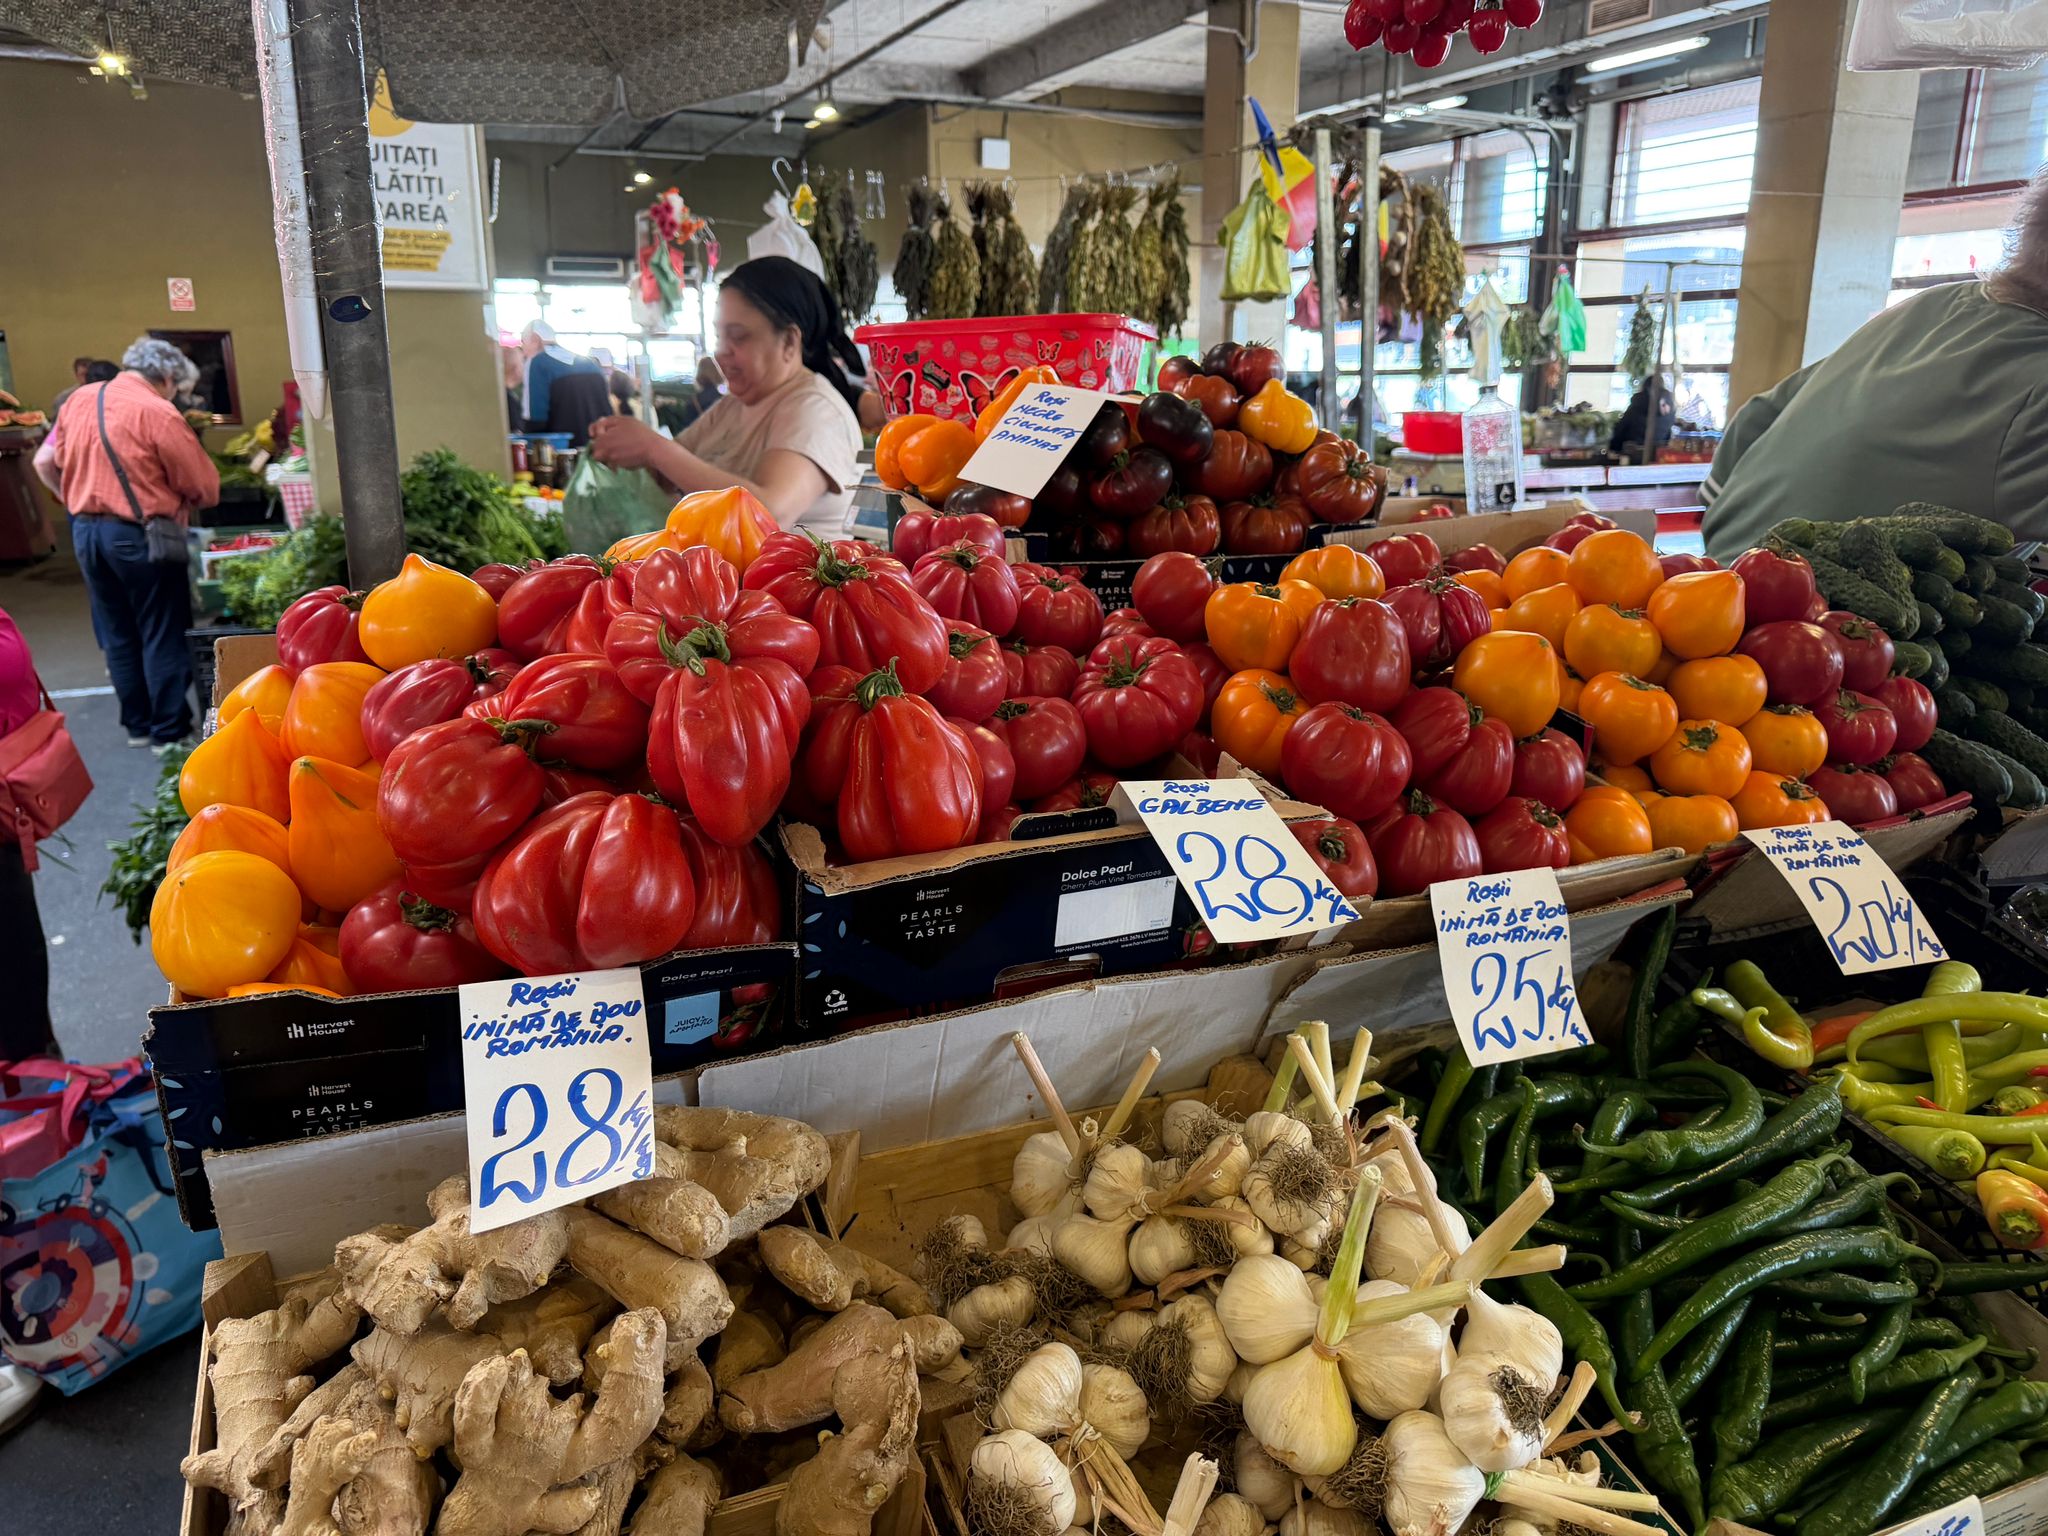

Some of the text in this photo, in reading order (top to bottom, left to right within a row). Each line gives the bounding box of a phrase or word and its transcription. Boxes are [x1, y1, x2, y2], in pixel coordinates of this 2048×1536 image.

[991, 430, 1062, 451] ANANAS
[1138, 797, 1267, 815] GALBENE
[1812, 840, 1834, 854] DE
[1060, 869, 1162, 892] Cherry Plum Vine Tomatoes
[1061, 861, 1133, 882] Dolce Pearl
[926, 887, 950, 895] Harvest
[900, 904, 963, 923] PEARLS
[1503, 907, 1534, 927] DE
[1534, 900, 1568, 920] BOU
[905, 924, 956, 940] TASTE
[925, 919, 937, 927] OF
[661, 973, 698, 983] Dolce
[700, 966, 733, 977] Pearl
[550, 1010, 583, 1031] DE
[590, 999, 643, 1025] BOU
[307, 1019, 356, 1030] Harvest
[308, 1027, 346, 1037] House
[292, 1100, 373, 1119] PEARLS
